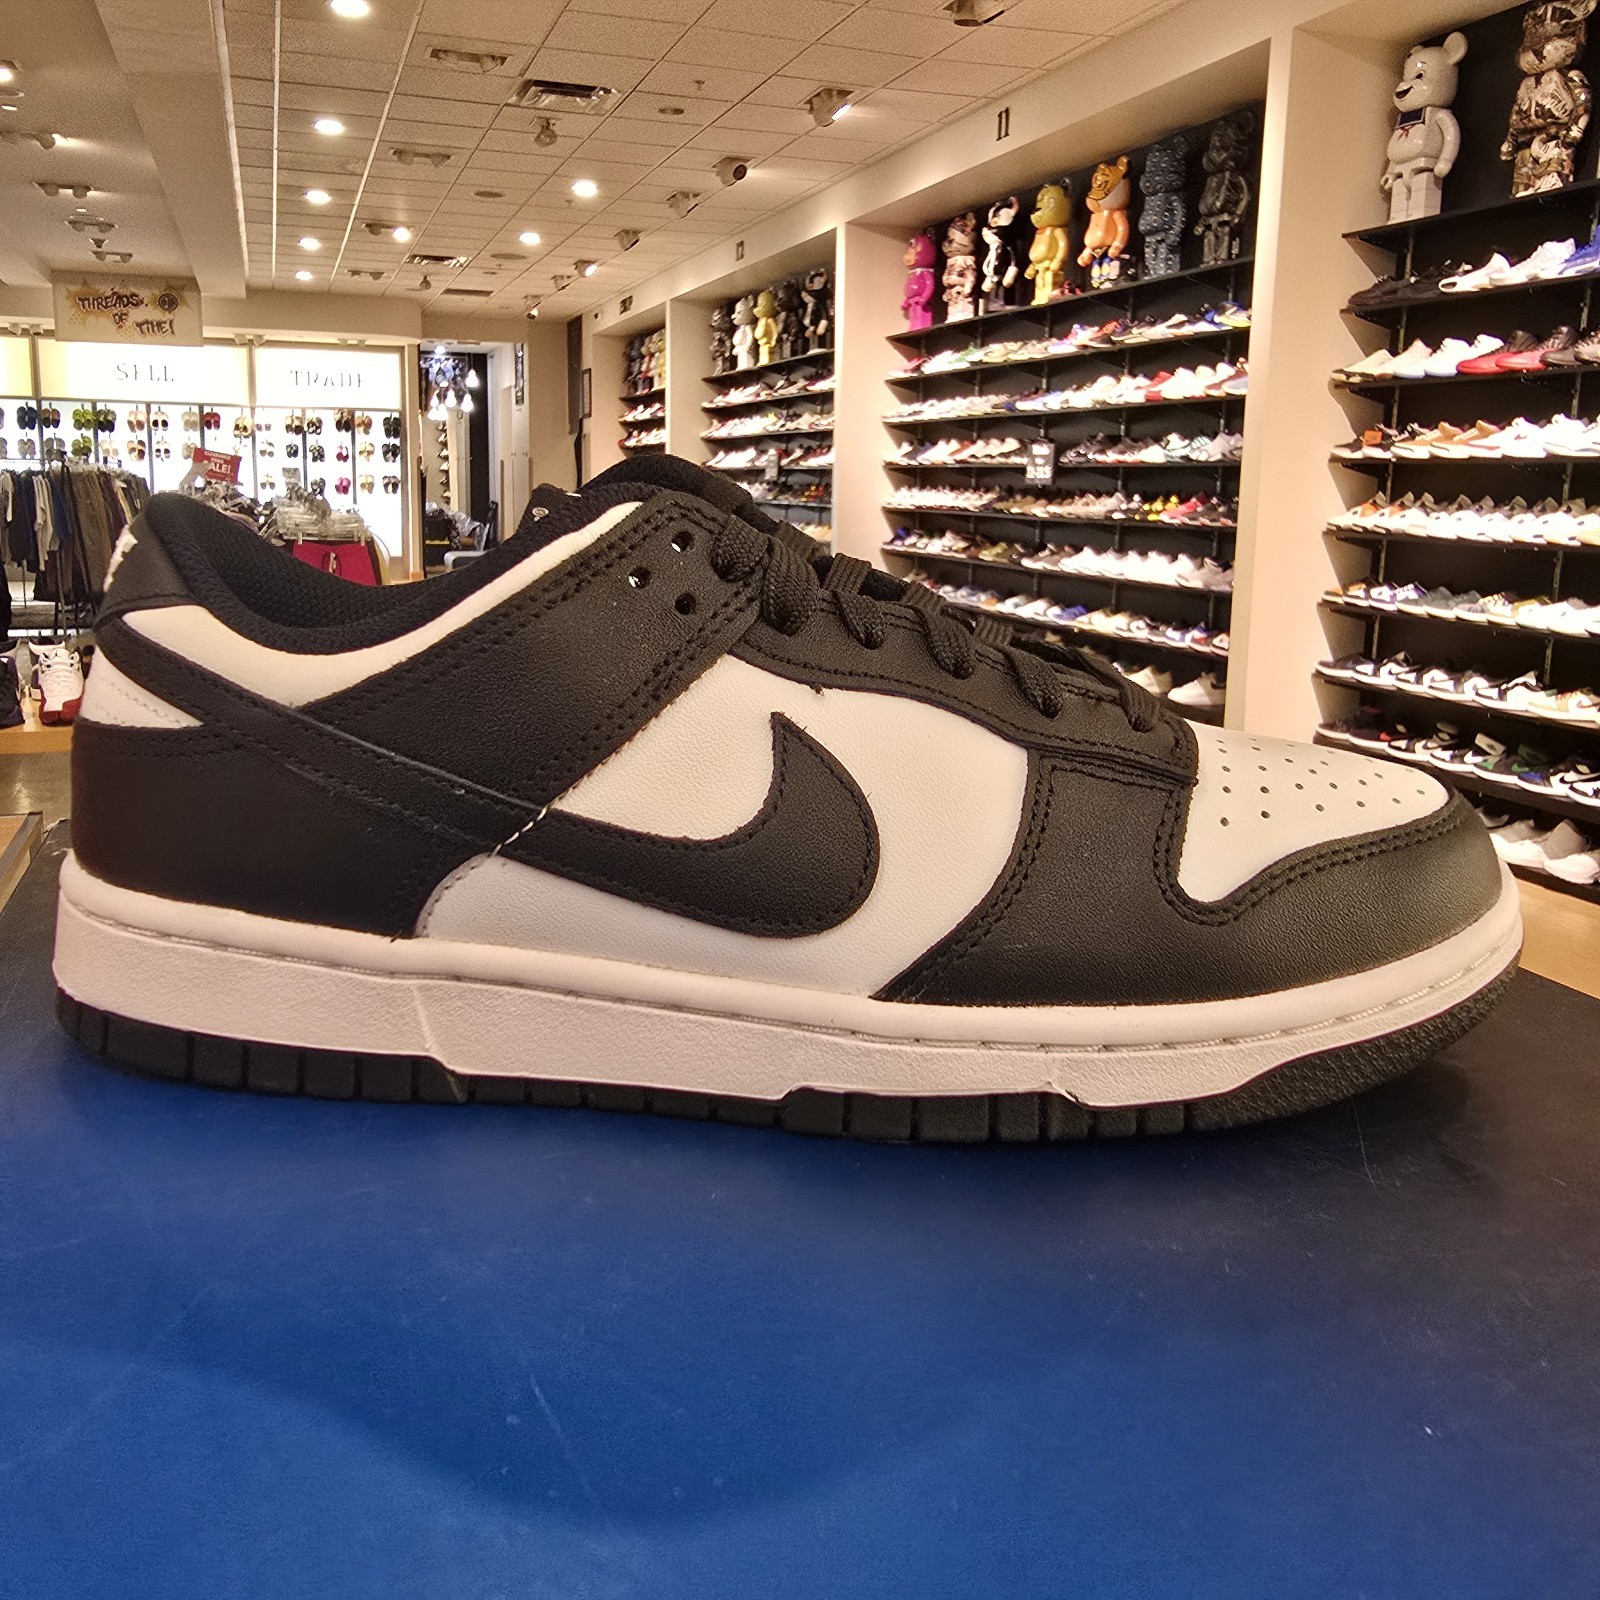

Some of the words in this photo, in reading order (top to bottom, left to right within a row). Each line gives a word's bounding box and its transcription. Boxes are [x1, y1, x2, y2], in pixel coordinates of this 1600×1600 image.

[996, 106, 1010, 141] 11
[116, 362, 175, 383] SELL
[290, 369, 362, 389] TRADE
